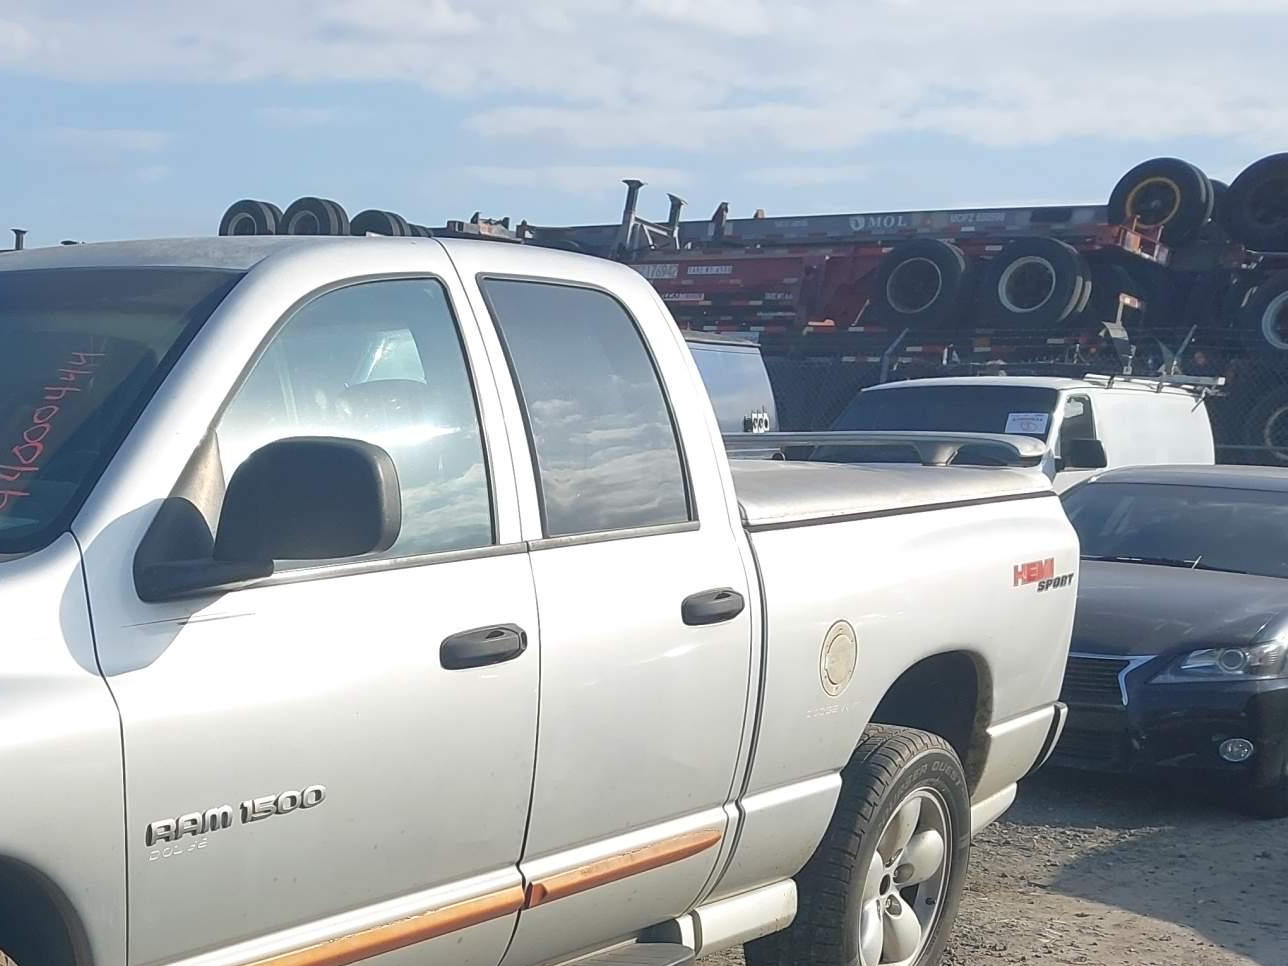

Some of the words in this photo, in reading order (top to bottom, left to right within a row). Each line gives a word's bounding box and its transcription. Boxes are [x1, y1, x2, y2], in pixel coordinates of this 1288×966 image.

[868, 215, 907, 228] MOL
[1037, 573, 1075, 593] SPORT
[146, 804, 234, 847] RAM
[239, 784, 327, 825] 1500
